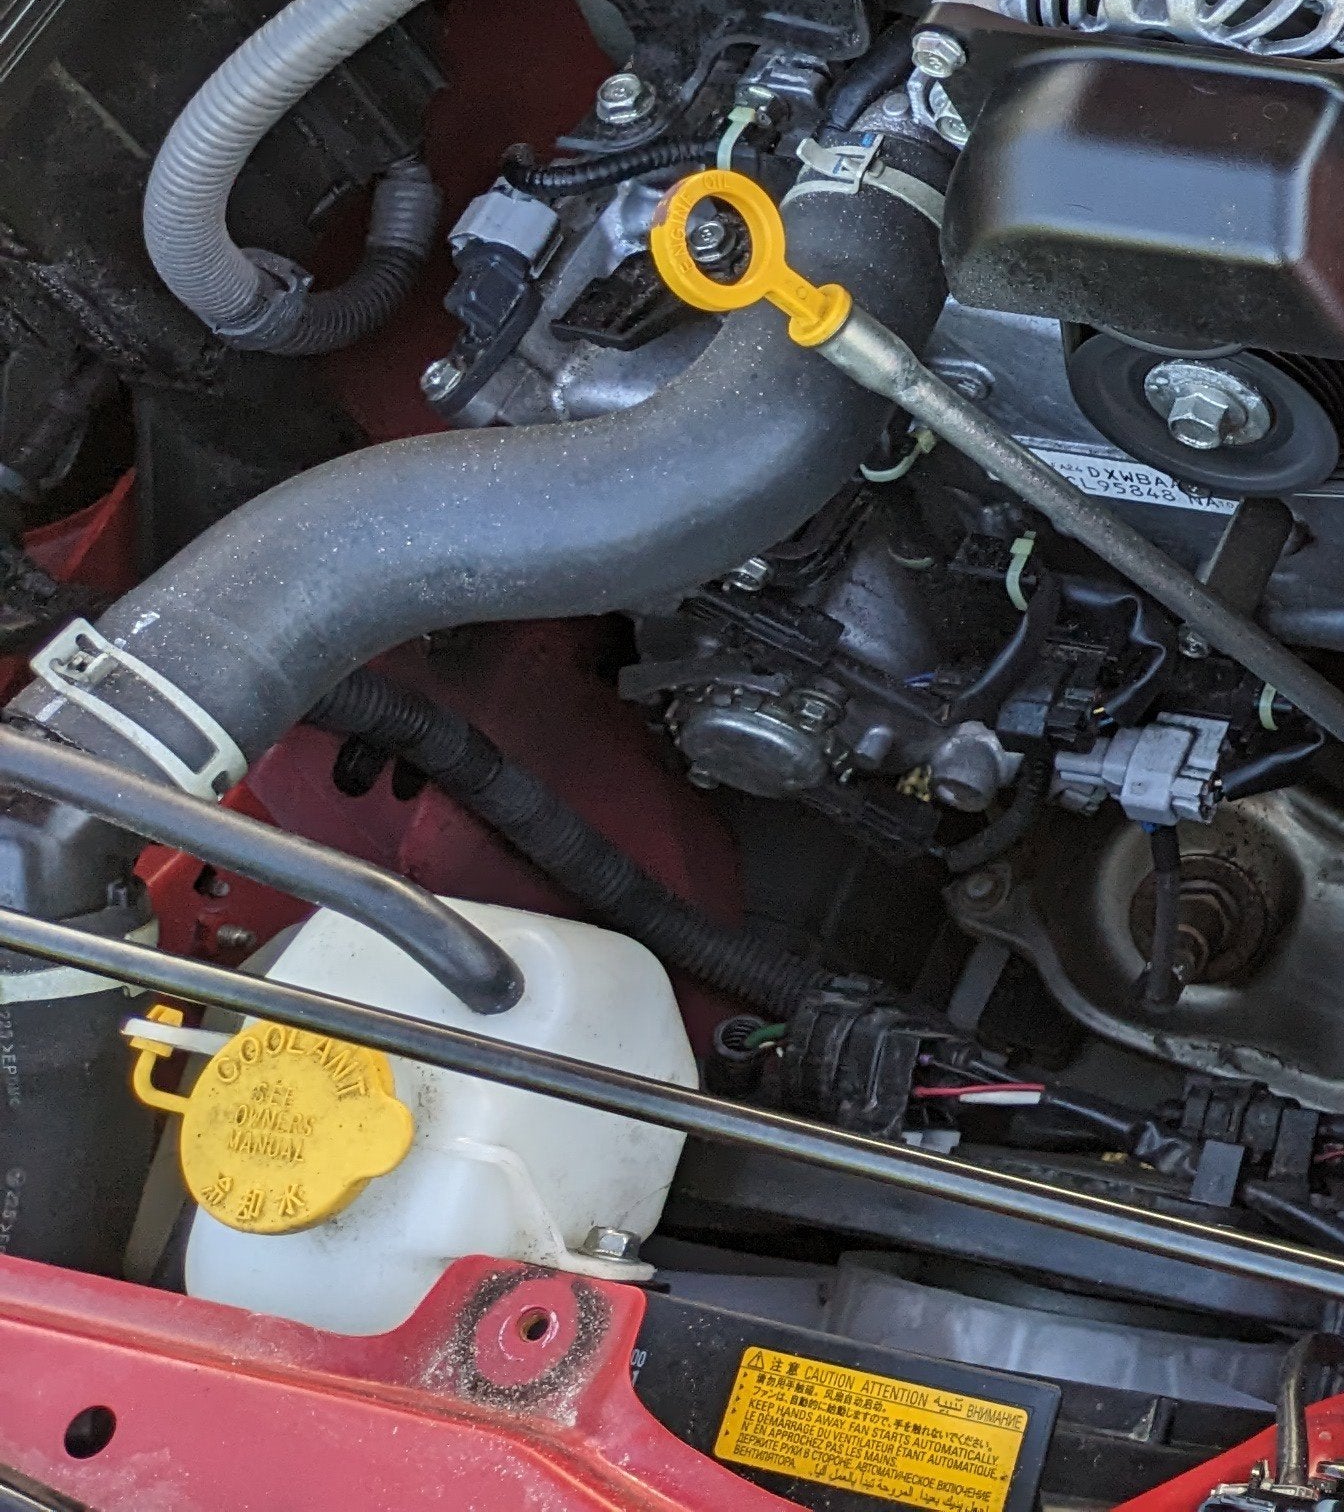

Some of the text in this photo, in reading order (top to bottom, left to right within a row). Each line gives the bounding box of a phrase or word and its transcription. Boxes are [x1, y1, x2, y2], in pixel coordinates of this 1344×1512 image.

[670, 173, 733, 273] ENGINE OIL
[217, 1025, 367, 1097] COOLANT
[250, 1081, 295, 1107] SEE
[227, 1129, 306, 1163] MANUAL
[802, 1365, 929, 1407] CAUTION ATTENTION
[743, 1409, 757, 1421] LE
[755, 1411, 817, 1436] DÉMARRAGE
[815, 1426, 832, 1440] DU
[830, 1430, 895, 1455] VENTILATEUR
[894, 1443, 928, 1462] ÉTANT
[747, 1398, 775, 1413] KEEP
[774, 1404, 814, 1422] HANDS
[847, 1421, 871, 1436] FAN
[870, 1427, 911, 1446] STARTS
[965, 1403, 1023, 1429] ВНИМАНИЕ
[735, 1431, 780, 1451] ДЕРЖИТЕ
[752, 1423, 768, 1436] EN
[766, 1426, 825, 1450] APPROCHEZ
[824, 1440, 844, 1454] PAS
[844, 1445, 863, 1459] LES
